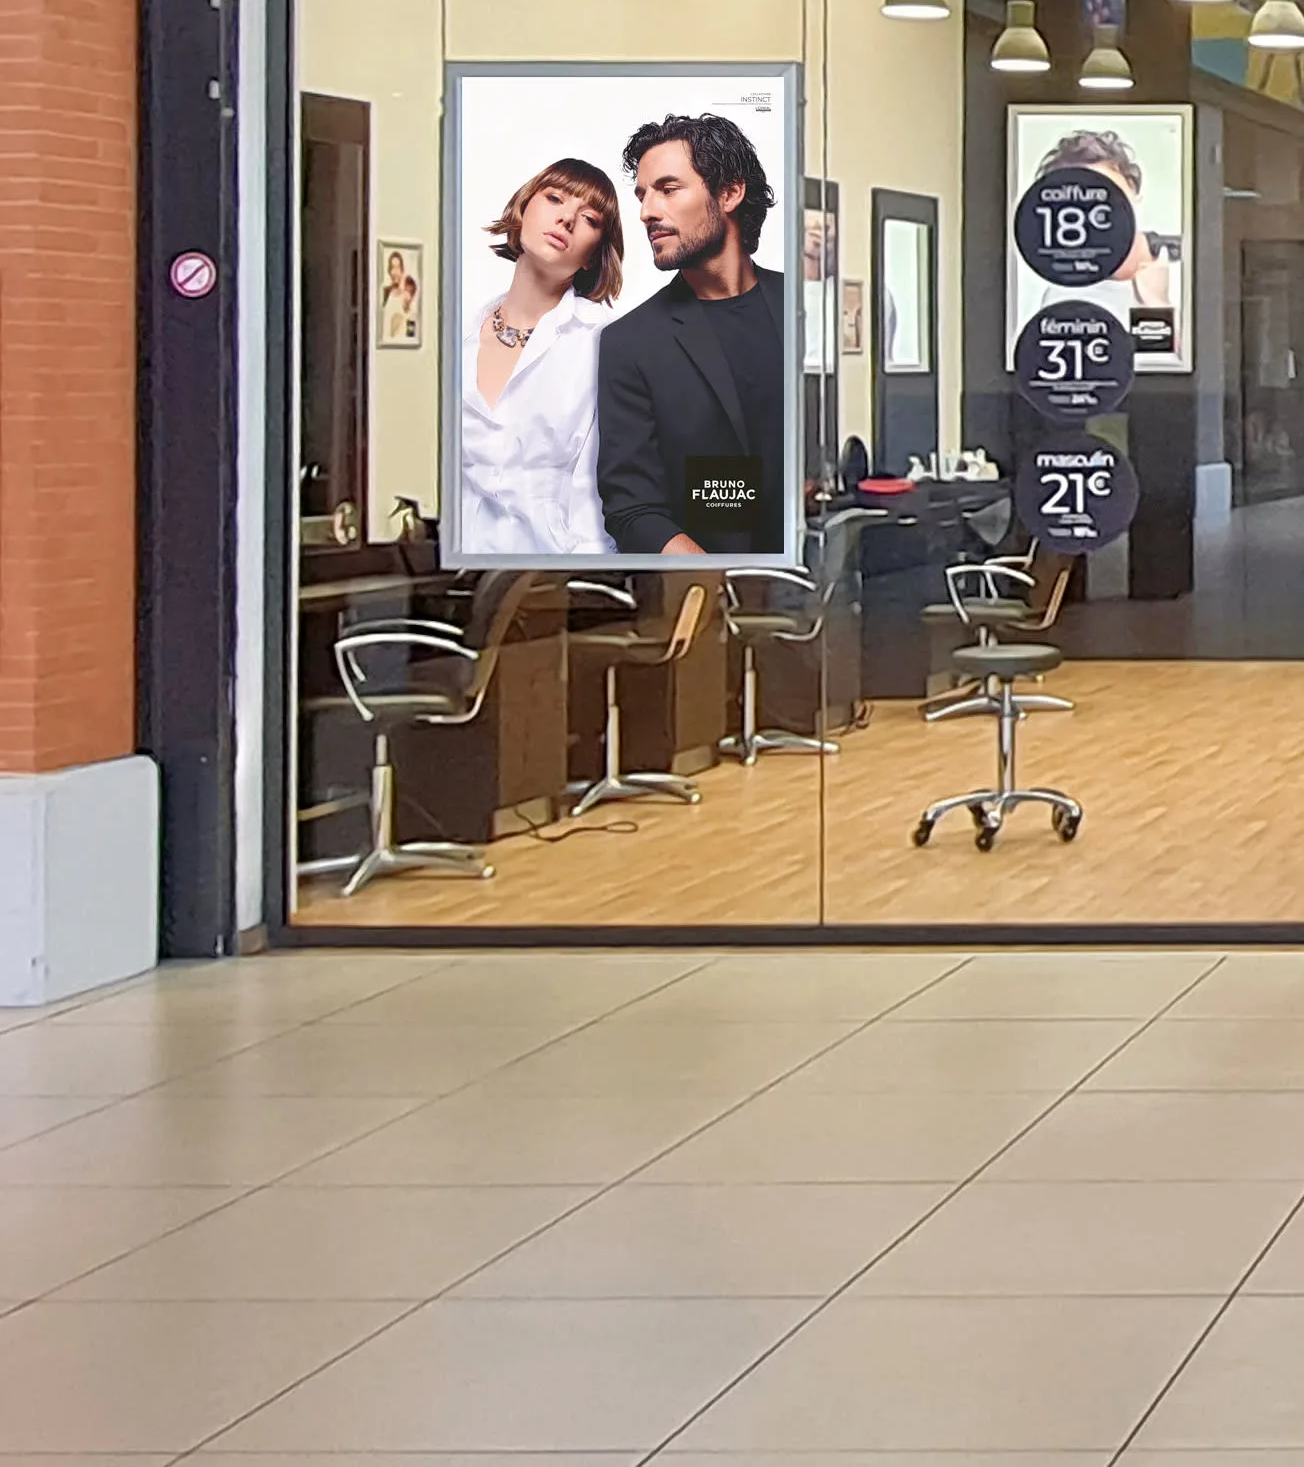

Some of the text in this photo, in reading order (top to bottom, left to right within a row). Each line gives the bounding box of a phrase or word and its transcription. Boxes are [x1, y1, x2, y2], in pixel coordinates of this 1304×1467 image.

[1041, 184, 1108, 201] coiffure
[1036, 204, 1112, 247] 18€
[1040, 317, 1108, 334] féminin
[1038, 338, 1110, 380] 31€
[704, 479, 745, 488] BRUNO
[1040, 471, 1111, 513] 21€
[692, 489, 756, 500] FLAUJAC
